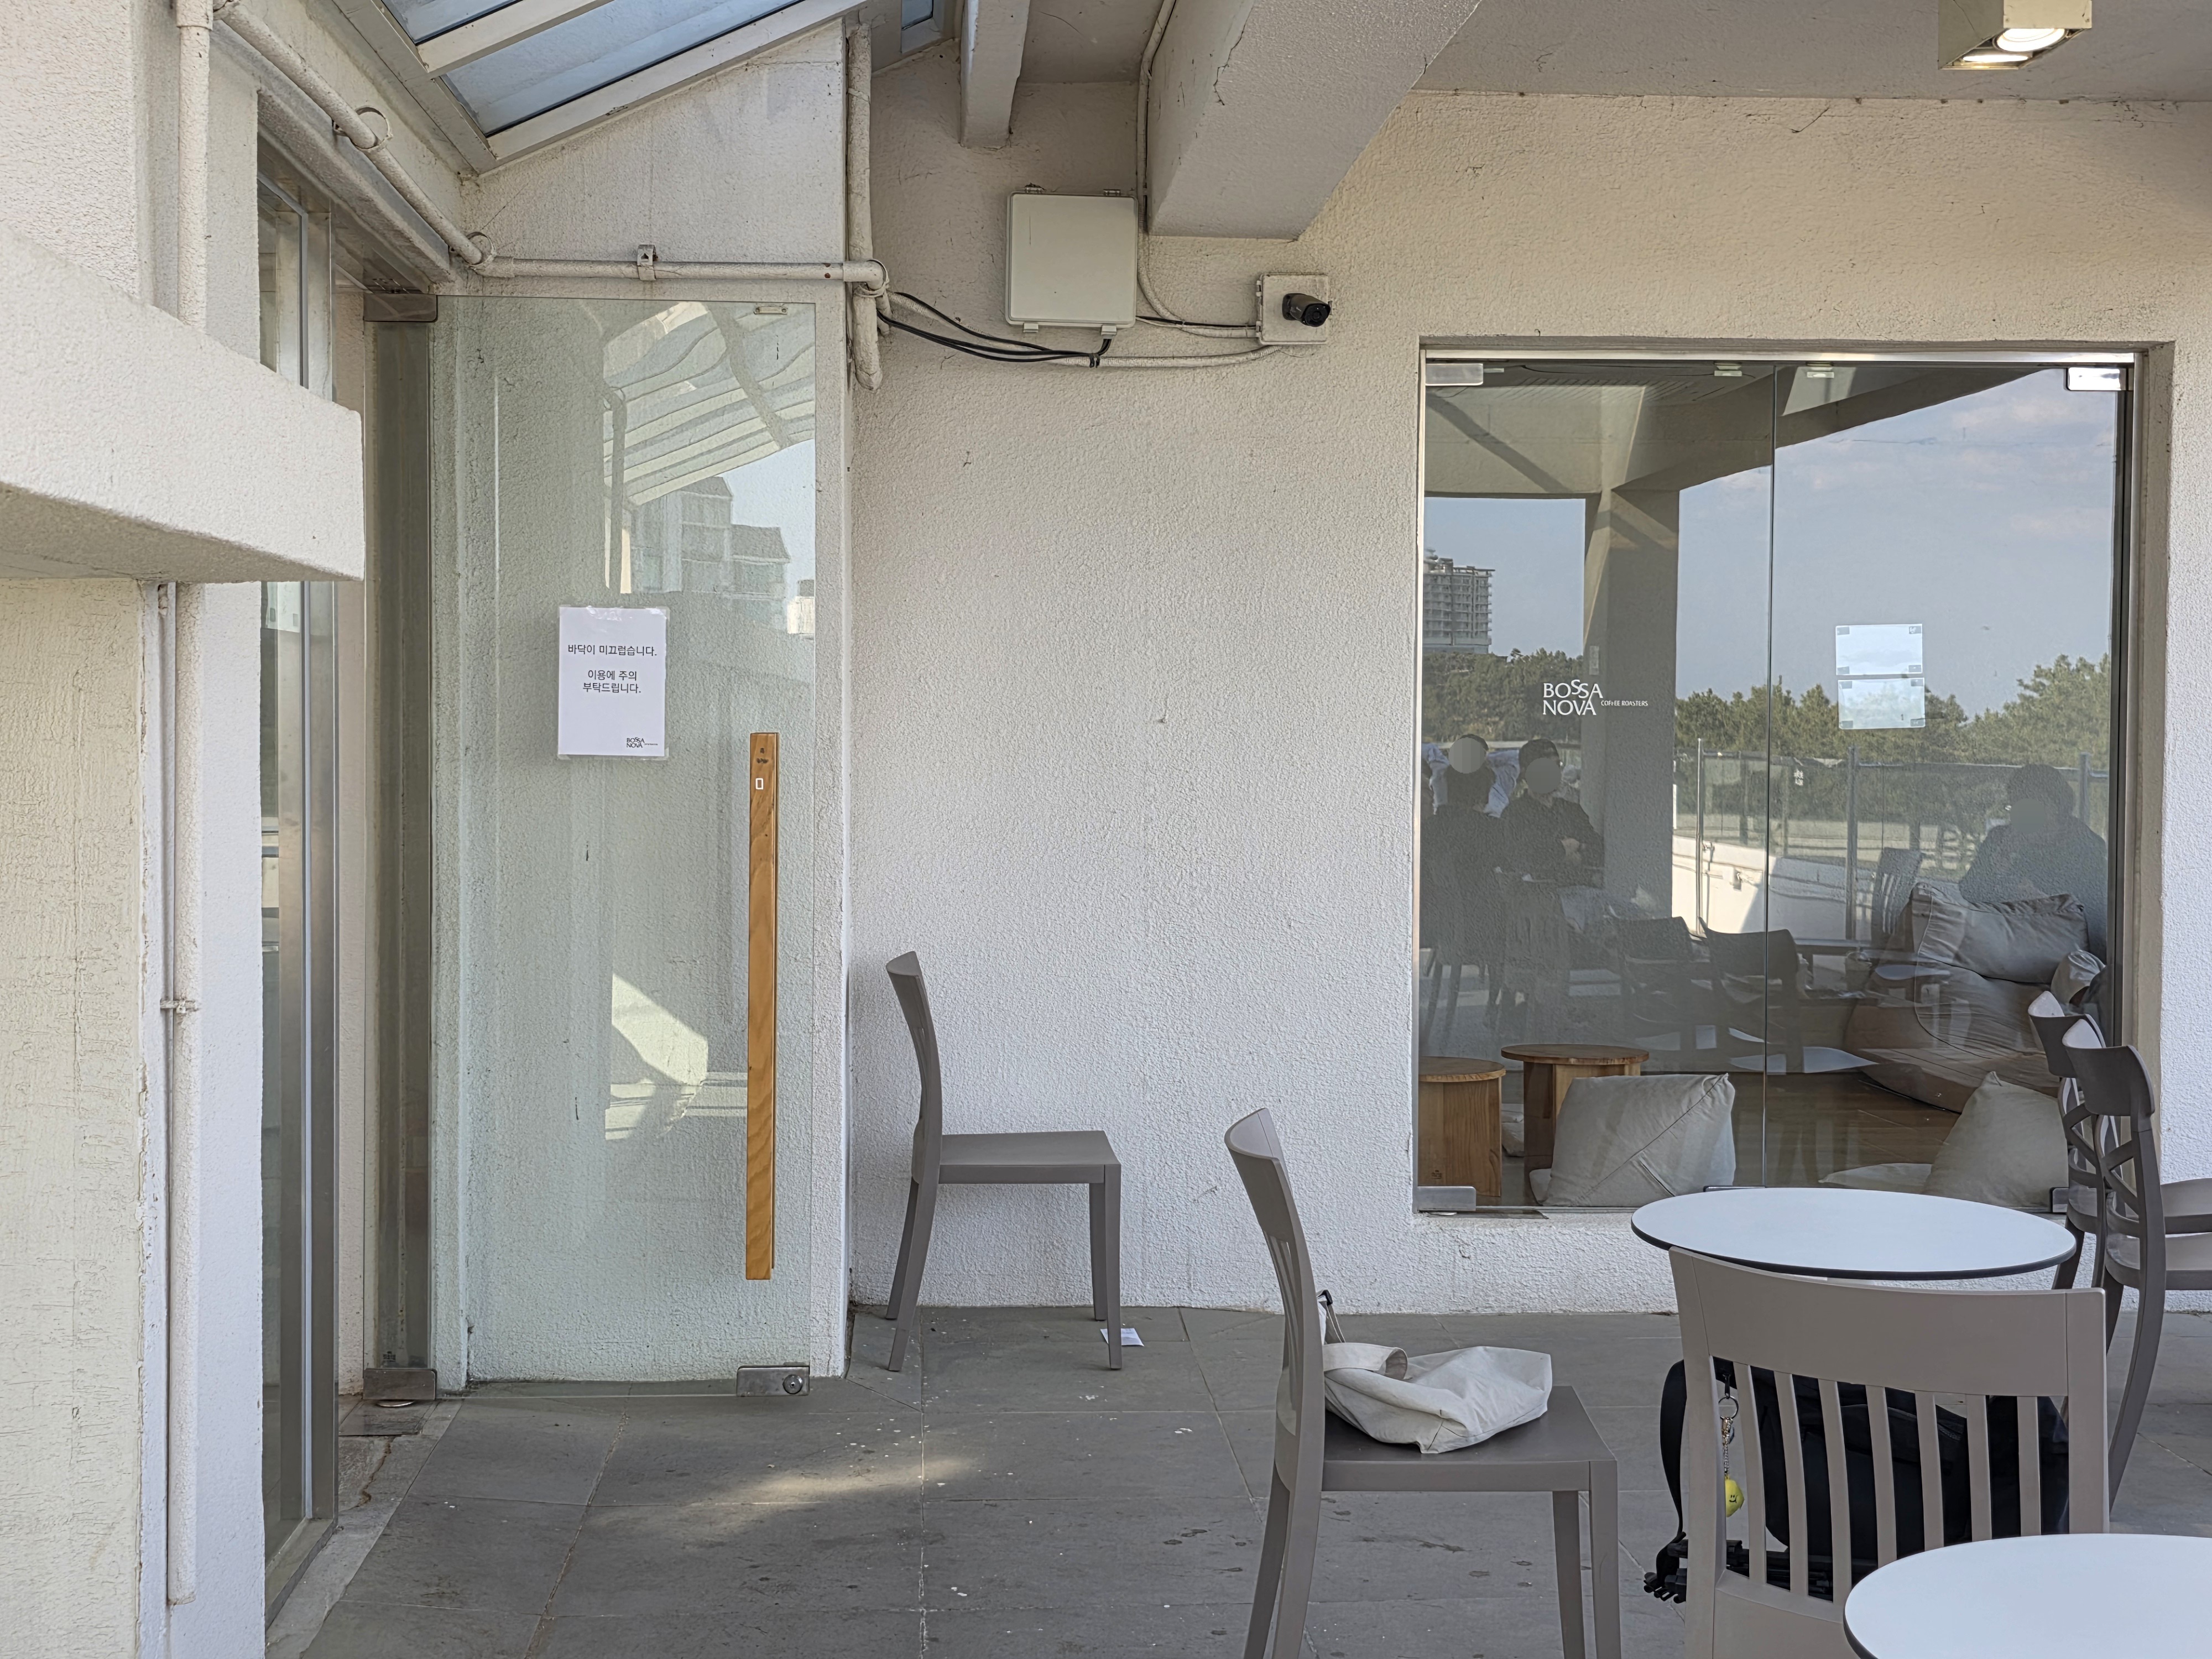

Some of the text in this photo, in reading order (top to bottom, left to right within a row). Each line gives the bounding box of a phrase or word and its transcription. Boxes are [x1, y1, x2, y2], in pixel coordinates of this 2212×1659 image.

[568, 645, 657, 656] 바닥이 미끄럽습니다.
[588, 670, 637, 681] 이용에 주의
[583, 682, 641, 693] 부탁드립니다.
[1543, 680, 1603, 698] BOSSA
[1543, 699, 1597, 715] NOVA
